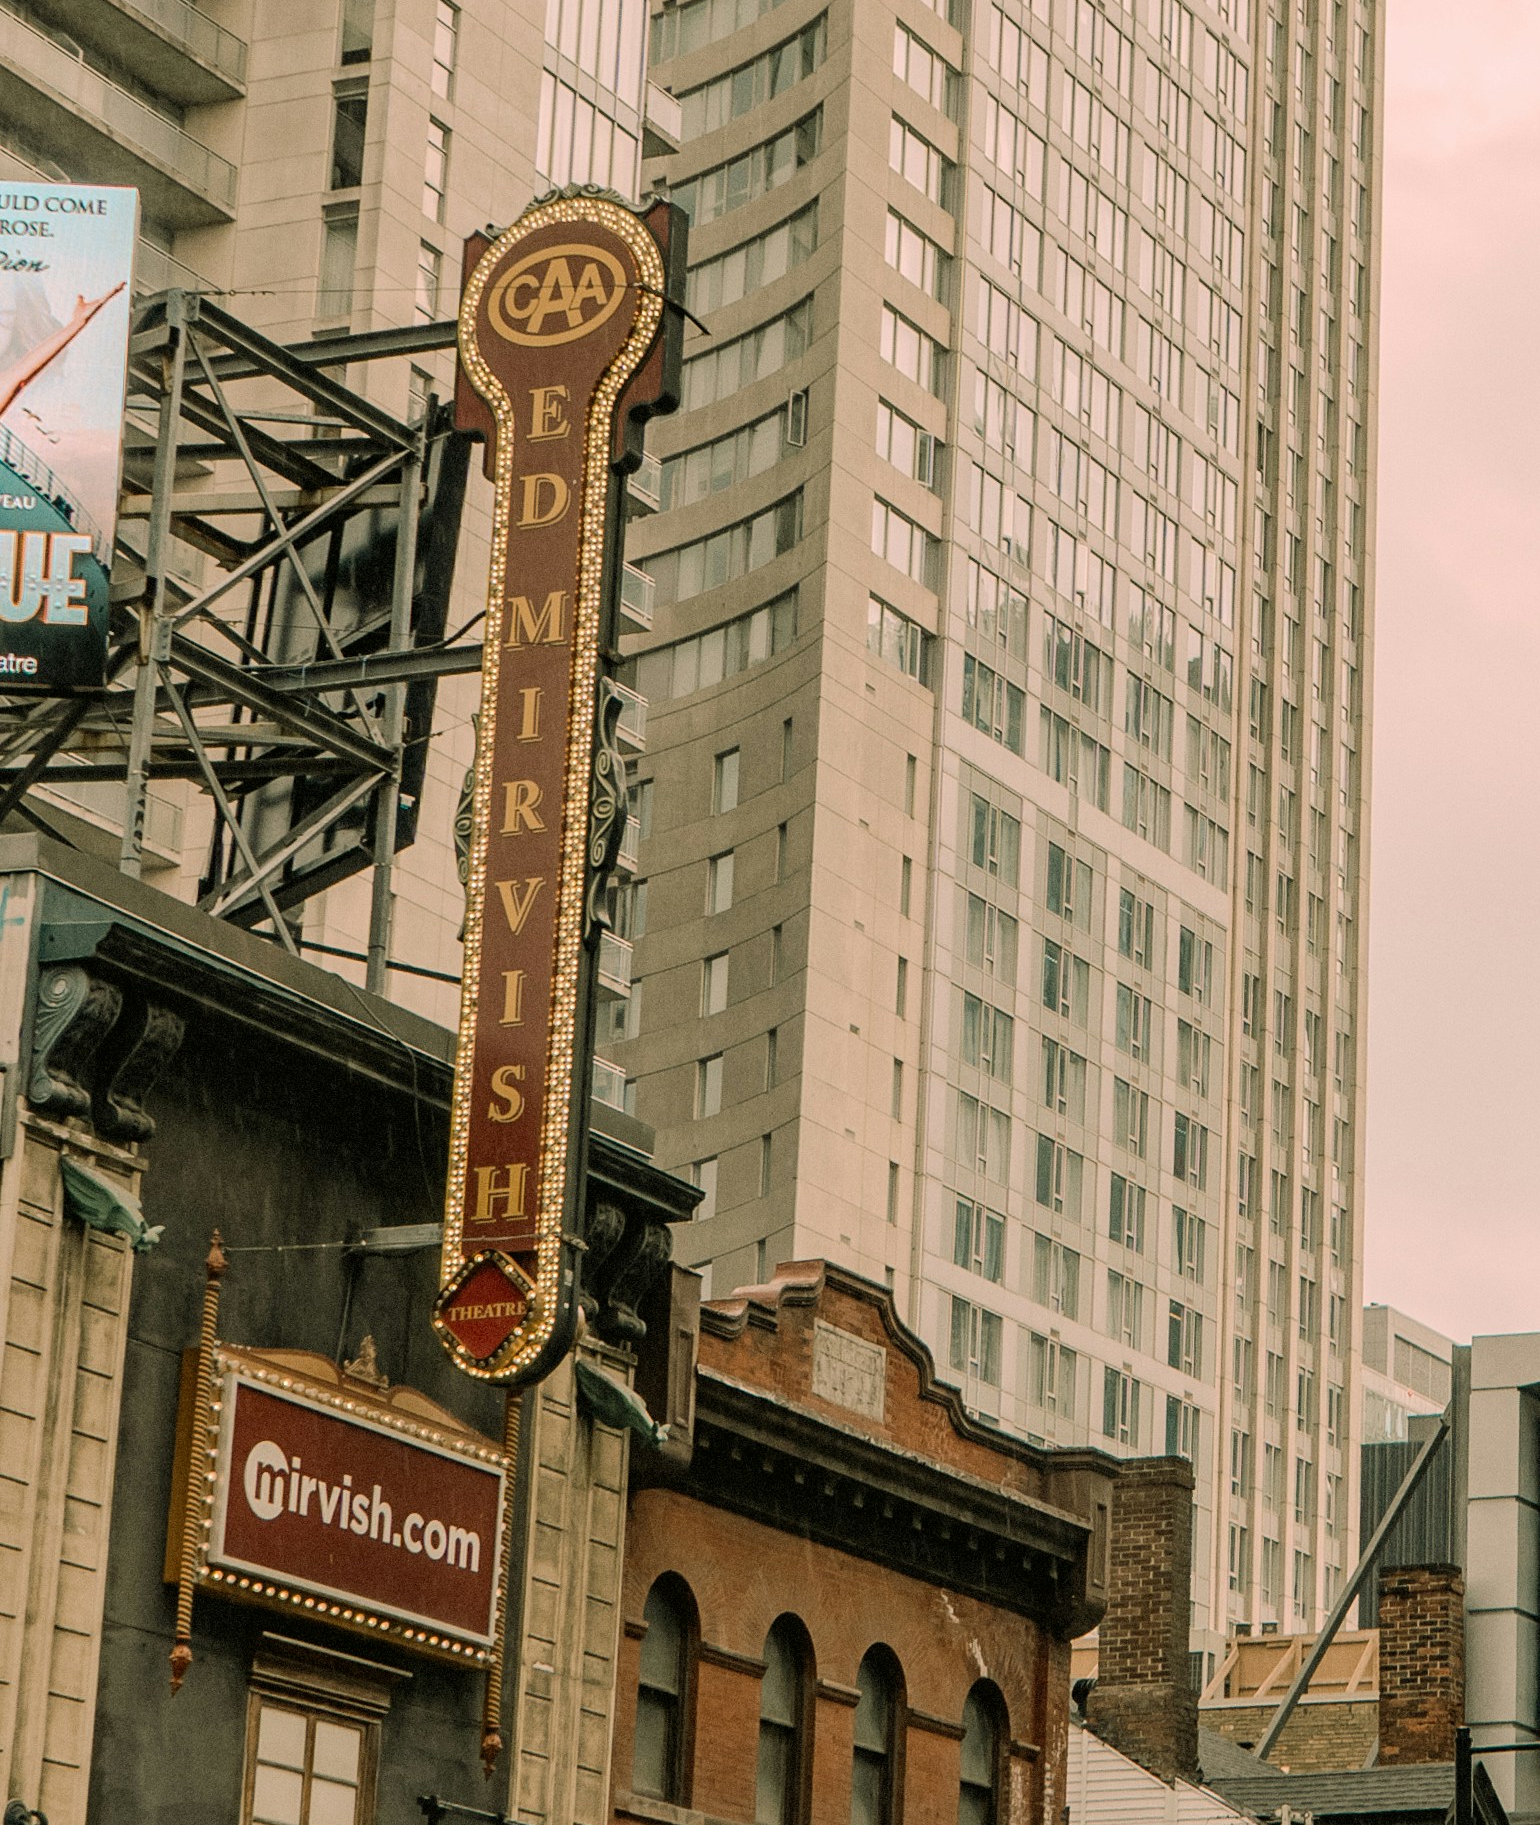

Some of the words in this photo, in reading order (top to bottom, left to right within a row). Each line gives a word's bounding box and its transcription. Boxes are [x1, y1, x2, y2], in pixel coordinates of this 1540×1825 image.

[44, 197, 107, 215] COME
[505, 258, 607, 334] CAA
[448, 1301, 527, 1322] THEATRE
[244, 1440, 481, 1576] mirvish.com
